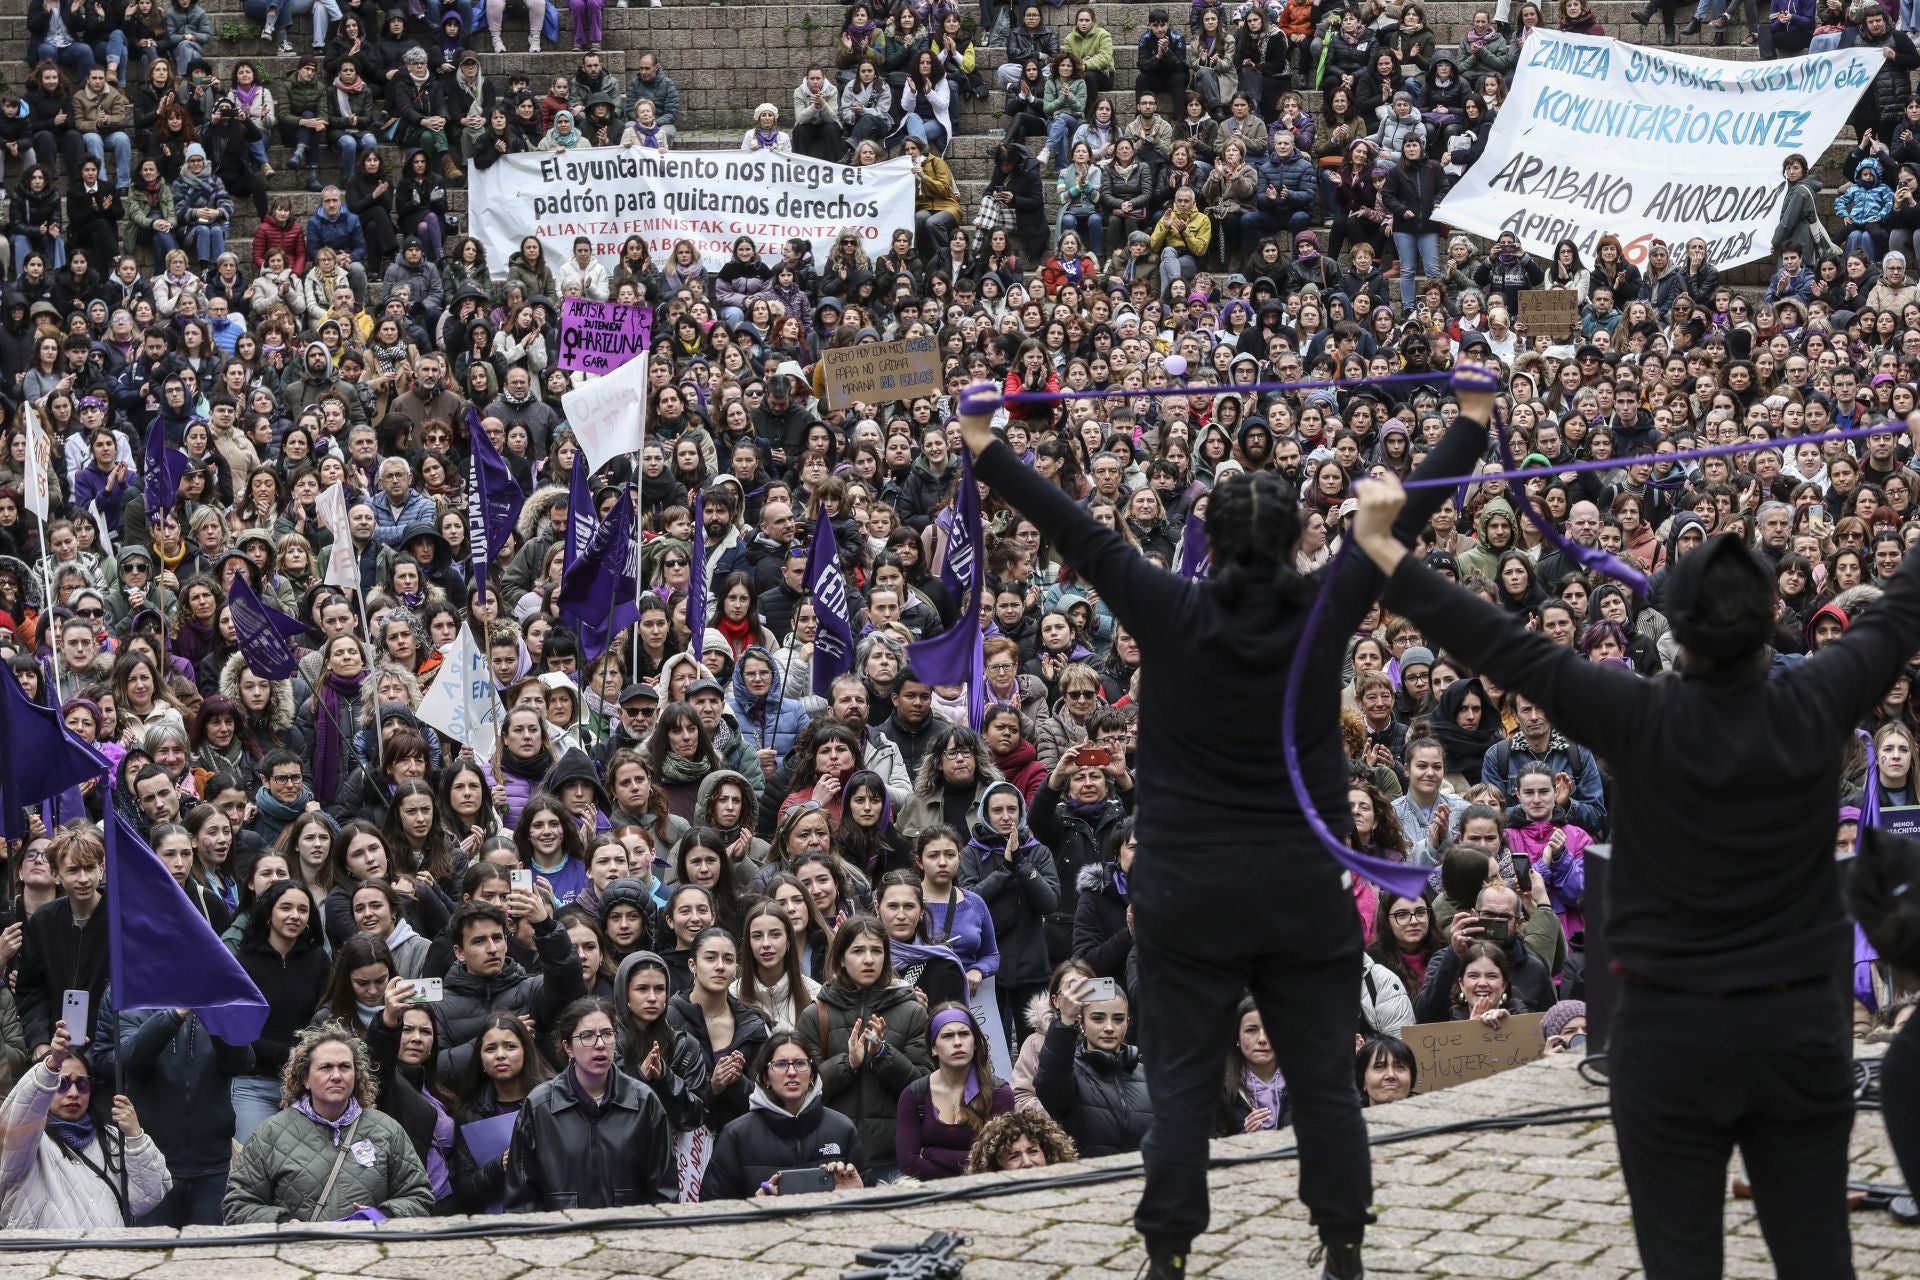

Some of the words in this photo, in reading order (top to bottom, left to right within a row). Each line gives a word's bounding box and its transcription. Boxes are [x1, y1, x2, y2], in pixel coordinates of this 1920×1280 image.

[1528, 39, 1611, 81] ZAINTZA
[1834, 58, 1871, 89] eta
[541, 157, 562, 183] El
[566, 155, 719, 186] ayuntamiento
[725, 162, 765, 182] nos
[771, 158, 834, 189] niega
[1488, 151, 1633, 215] ARABAKO
[1642, 181, 1787, 224] AKORDIOA
[534, 188, 608, 220] padrón
[615, 190, 656, 217] para
[663, 188, 770, 216] quitarnos
[776, 191, 878, 219] derechos
[536, 220, 618, 237] ALIANTZA
[624, 218, 723, 234] FEMINISTAK
[1622, 233, 1654, 265] 6
[613, 306, 628, 322] EZ
[583, 355, 608, 368] GARA
[856, 348, 870, 359] HOY
[872, 346, 887, 357] CON
[889, 342, 904, 354] MIS
[835, 366, 859, 380] PARA
[863, 362, 874, 374] NO
[900, 369, 934, 387] ELLAS
[1422, 1034, 1463, 1059] que
[1482, 1031, 1513, 1043] ser
